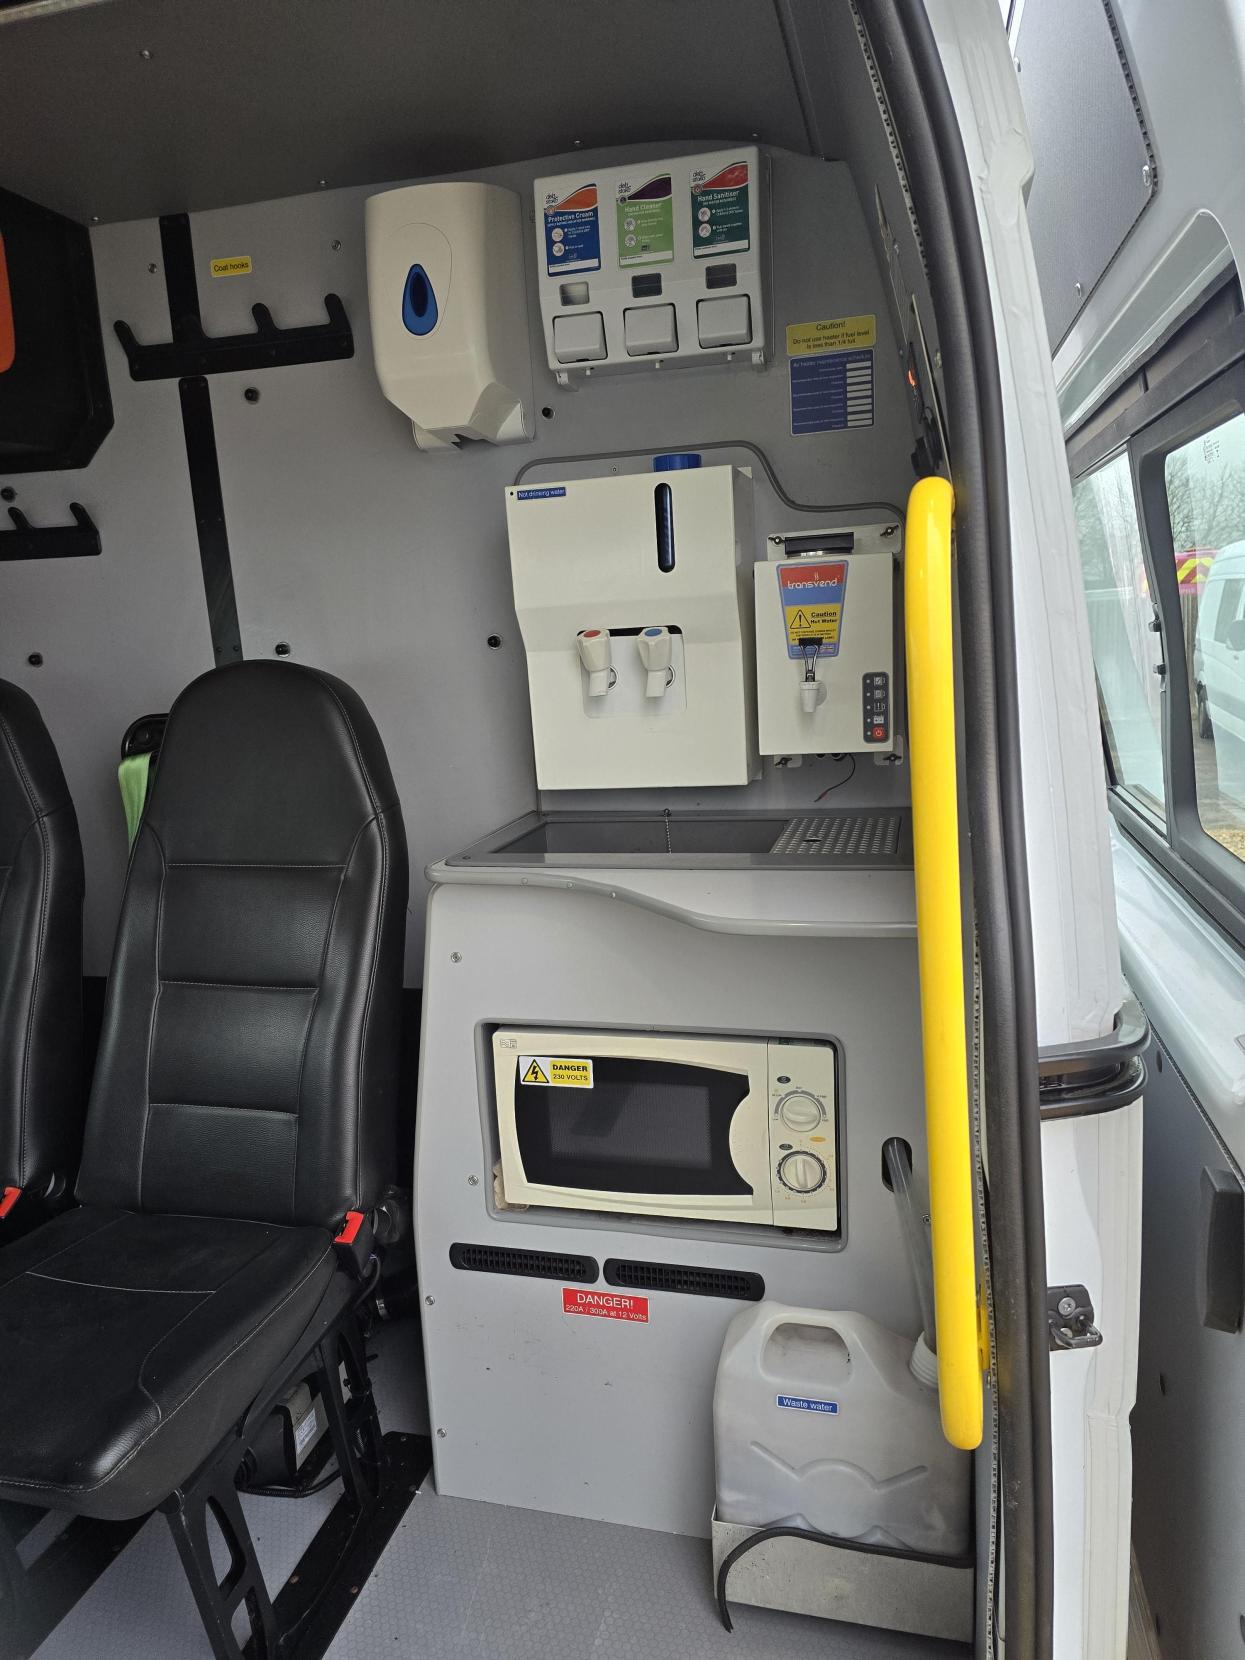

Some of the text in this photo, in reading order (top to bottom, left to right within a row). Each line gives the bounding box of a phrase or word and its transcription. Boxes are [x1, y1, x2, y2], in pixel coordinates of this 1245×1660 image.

[697, 193, 713, 202] Hand
[713, 190, 740, 200] Sanitiser
[624, 205, 640, 213] Hand
[640, 202, 663, 211] Cleaner
[548, 214, 575, 223] Protective
[575, 210, 594, 219] Cream
[213, 262, 249, 272] Coat hooks
[816, 320, 846, 332] Caution!
[822, 334, 840, 342] heater
[787, 577, 838, 590] transvend
[552, 1064, 588, 1072] DANGER
[577, 1293, 634, 1309] DANGER!
[565, 1304, 584, 1312] 220A
[589, 1307, 608, 1316] 300A
[628, 1312, 647, 1320] Volts
[782, 1398, 833, 1411] Waste water
